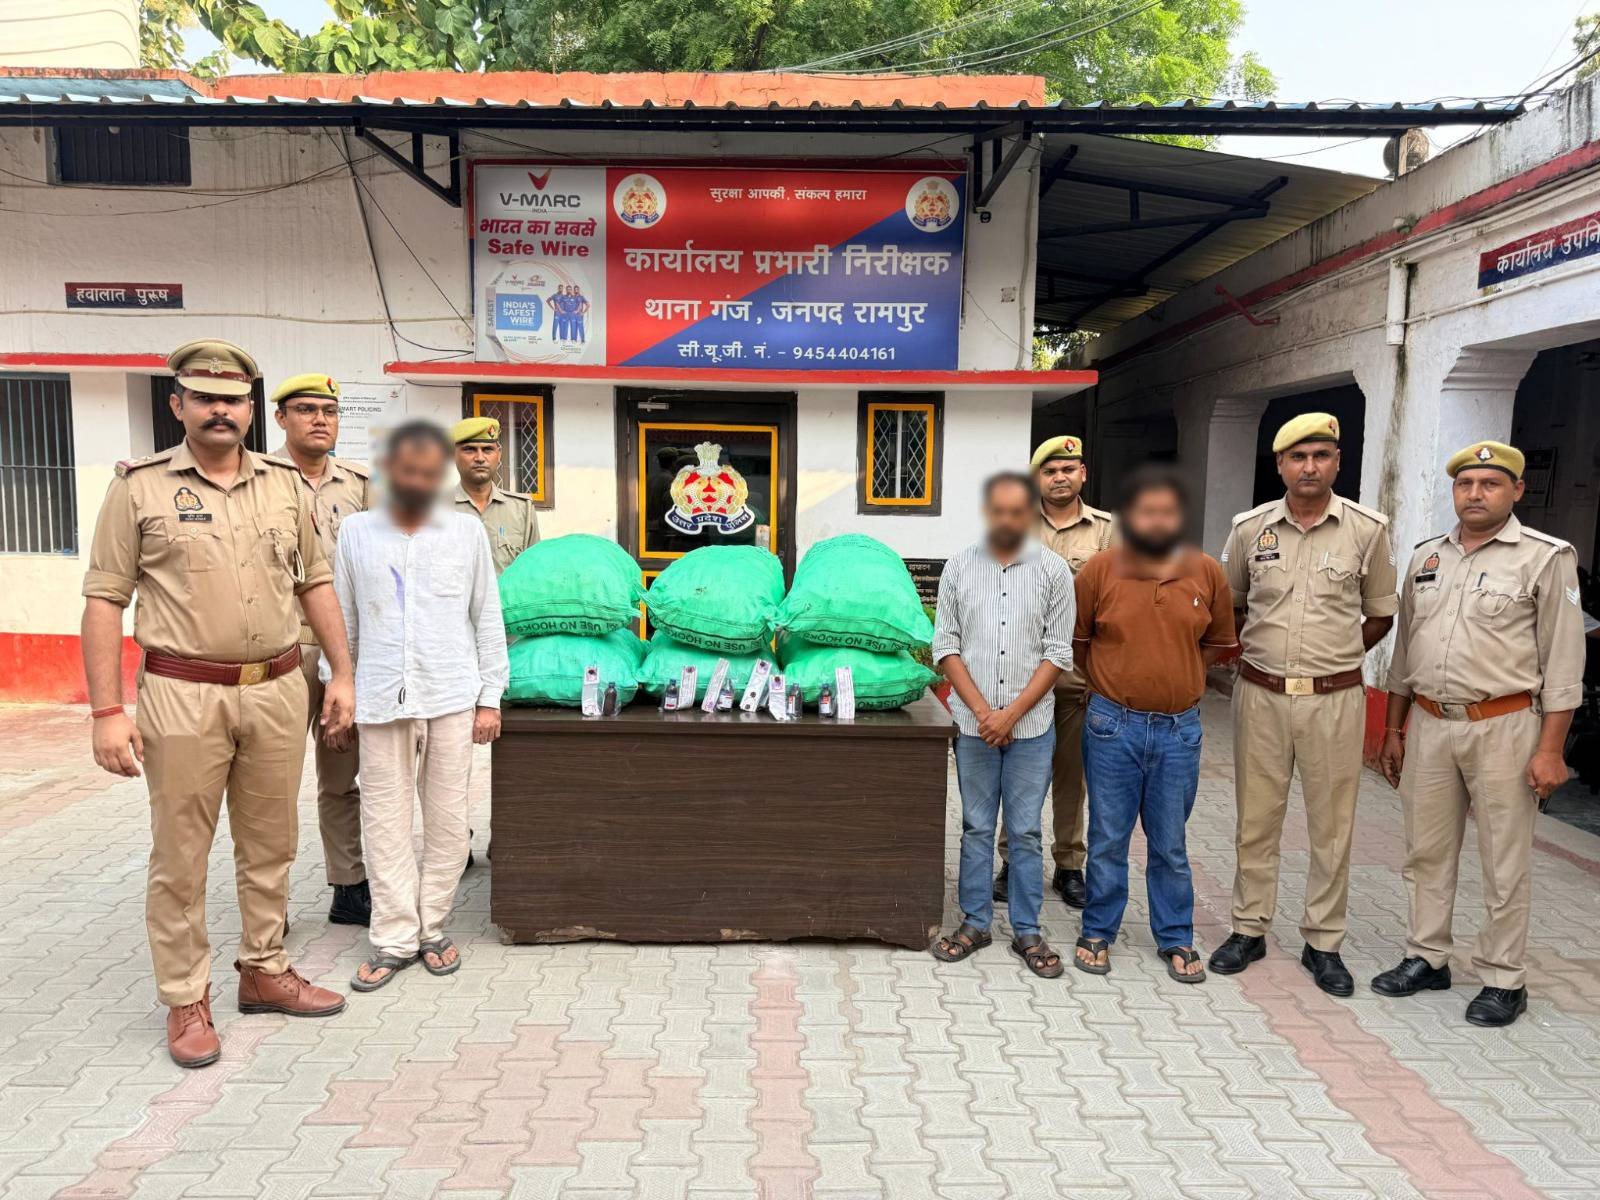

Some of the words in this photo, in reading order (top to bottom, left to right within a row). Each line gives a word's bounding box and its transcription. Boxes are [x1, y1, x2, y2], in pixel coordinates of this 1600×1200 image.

[500, 192, 581, 208] V-MARC
[710, 187, 743, 202] सुरक्षा
[795, 186, 830, 201] संकल्प
[834, 189, 867, 201] हमारा
[480, 218, 523, 235] भारत
[527, 219, 551, 236] का
[554, 216, 598, 237] सबसे
[488, 239, 534, 255] Safe
[541, 240, 590, 257] Wire
[623, 240, 744, 273] कार्यालय
[753, 243, 833, 276] प्रभारी
[842, 244, 952, 276] निरीक्षक
[1496, 239, 1555, 273] कार्यालय
[76, 287, 127, 303] हवालात
[503, 300, 537, 309] INDIA'S
[503, 309, 537, 318] SAFEST
[645, 299, 702, 321] थाना
[771, 301, 845, 325] जनपद
[853, 302, 929, 332] रामपुर
[510, 317, 535, 325] WIRE
[792, 346, 896, 360] 9454404161
[516, 620, 557, 633] HOOKS
[559, 620, 578, 631] NO
[580, 620, 601, 632] USE
[704, 639, 721, 649] NO
[724, 641, 746, 652] USE
[845, 636, 862, 646] NO
[865, 638, 887, 651] USE
[857, 700, 875, 709] NO
[878, 699, 899, 709] USE
